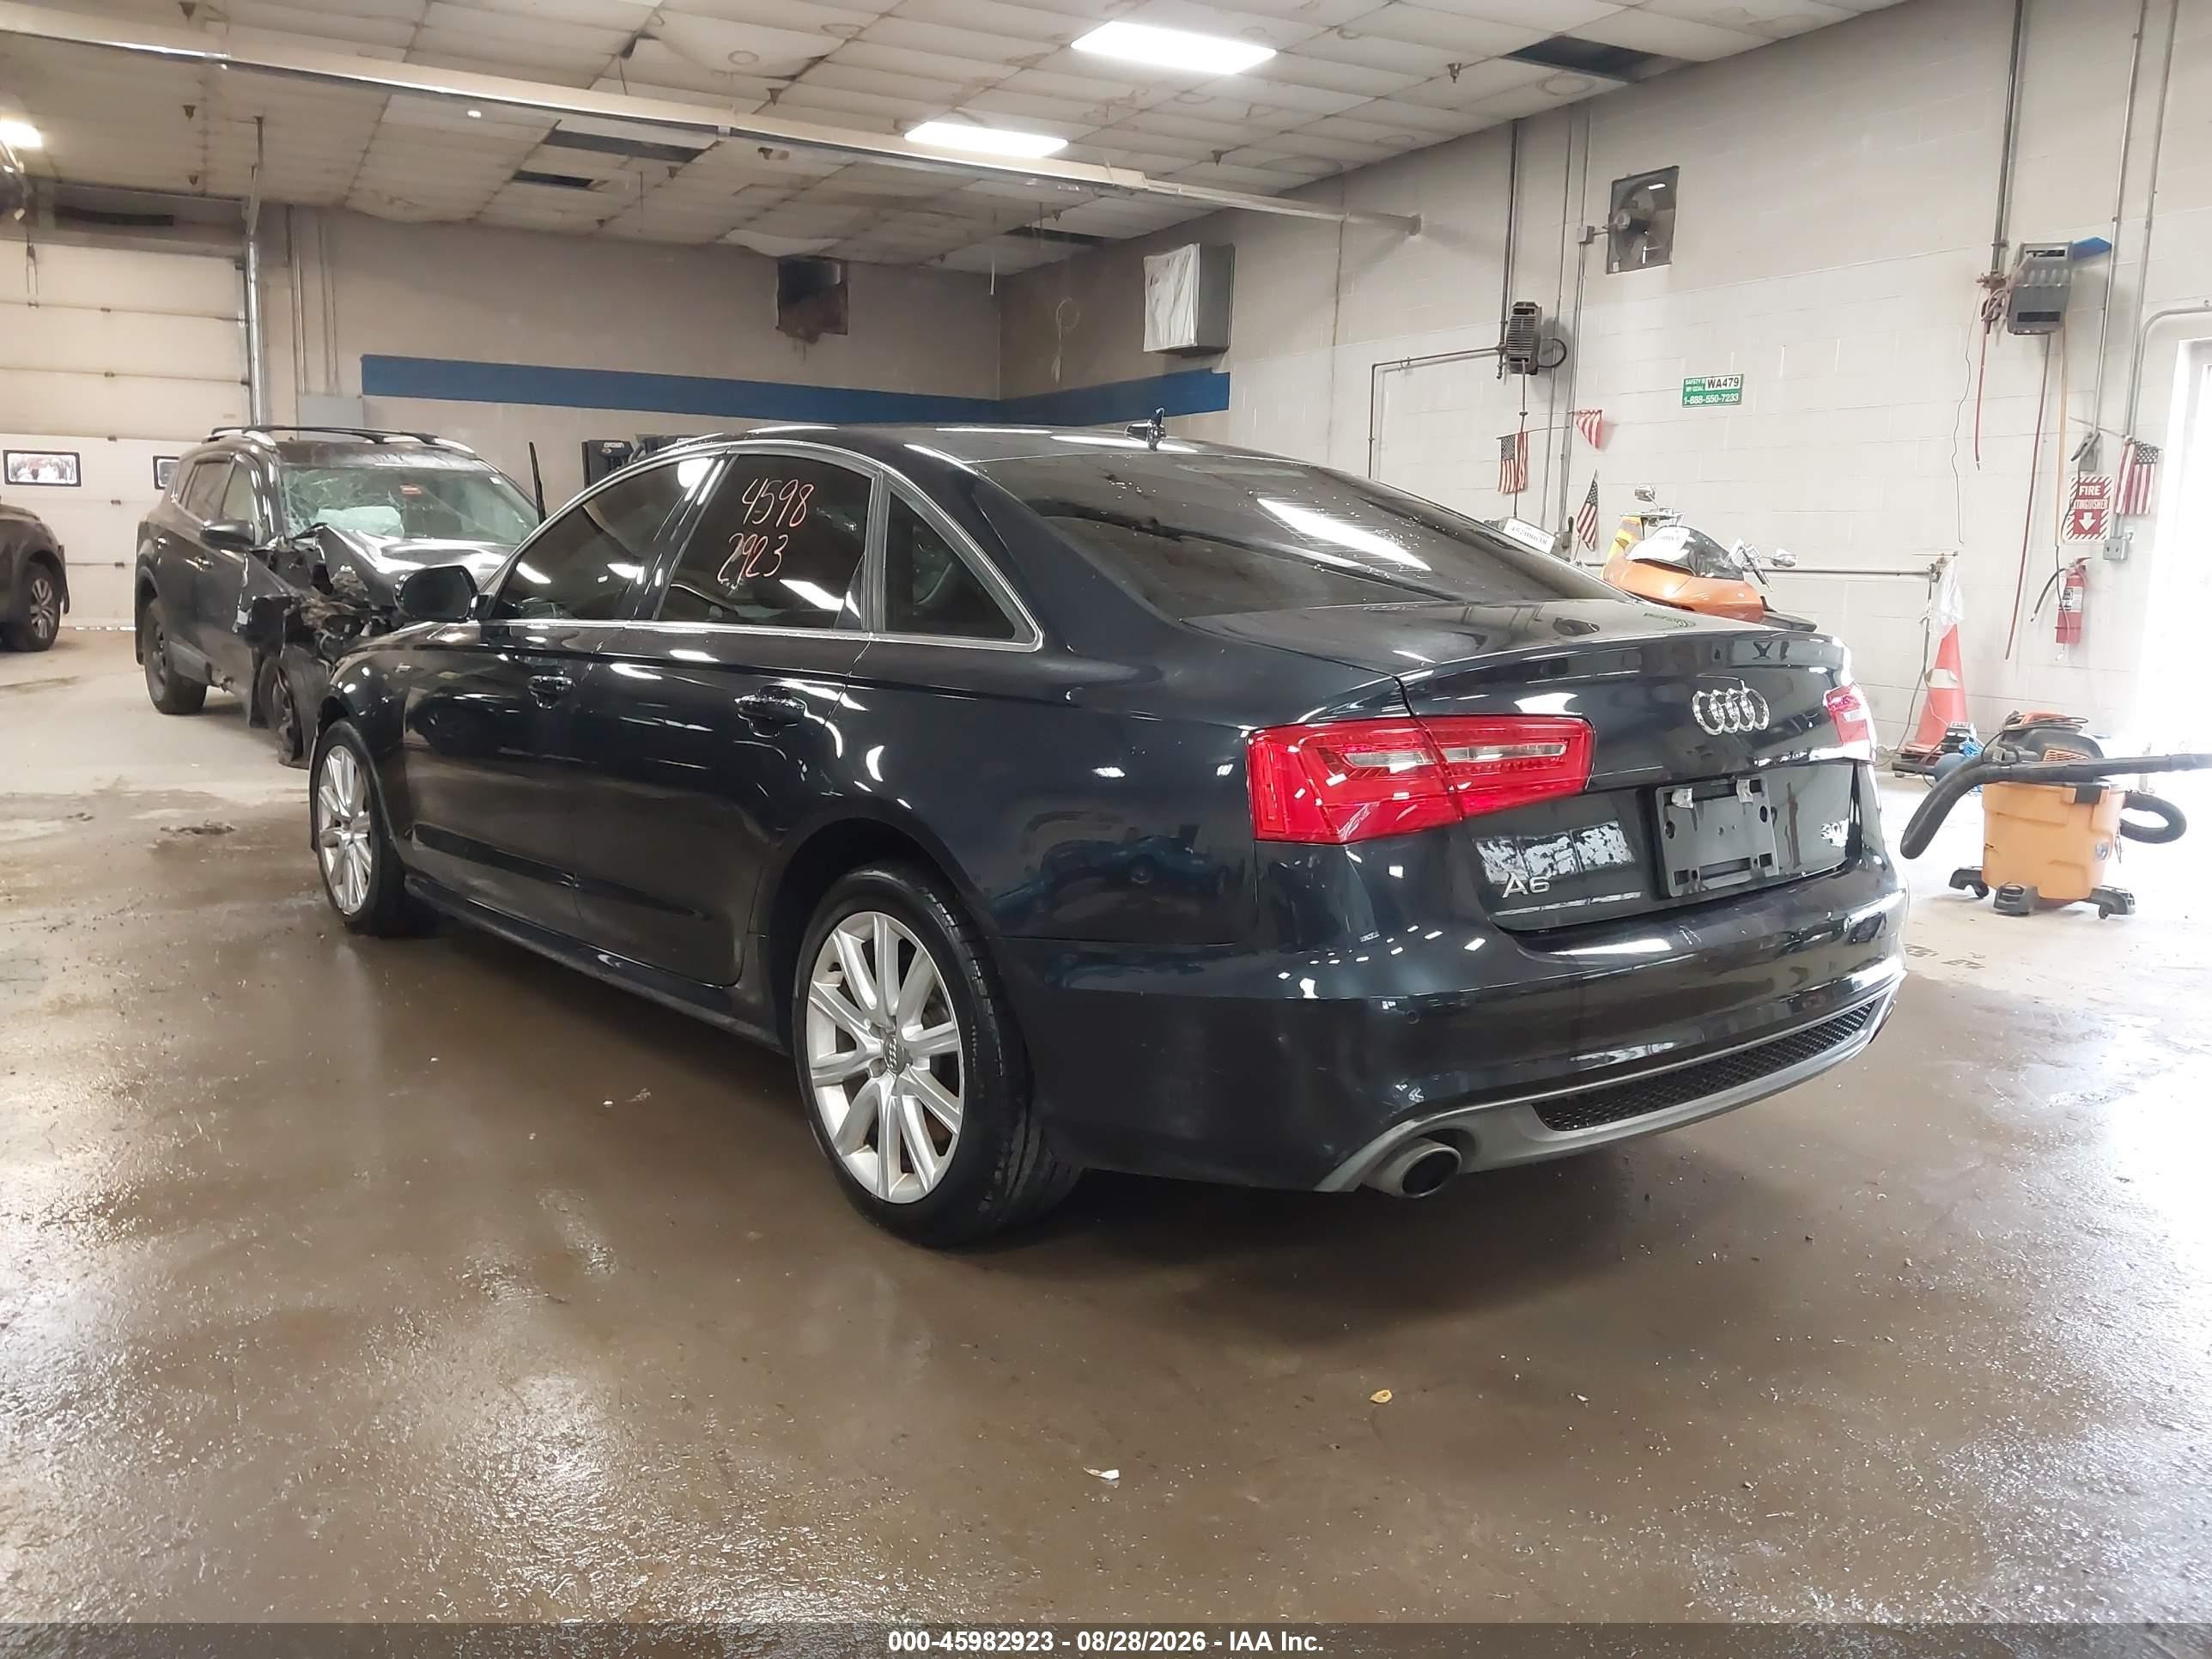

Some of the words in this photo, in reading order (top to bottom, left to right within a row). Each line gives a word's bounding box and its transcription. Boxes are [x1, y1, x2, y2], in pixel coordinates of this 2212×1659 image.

[1707, 377, 1740, 389] WA479
[1683, 393, 1739, 404] 1-888-550-7233
[2079, 485, 2102, 496] FIRE
[742, 477, 814, 527] 4598
[2071, 499, 2108, 509] TINGUISHER
[717, 532, 788, 586] 2923
[1502, 872, 1551, 898] A6
